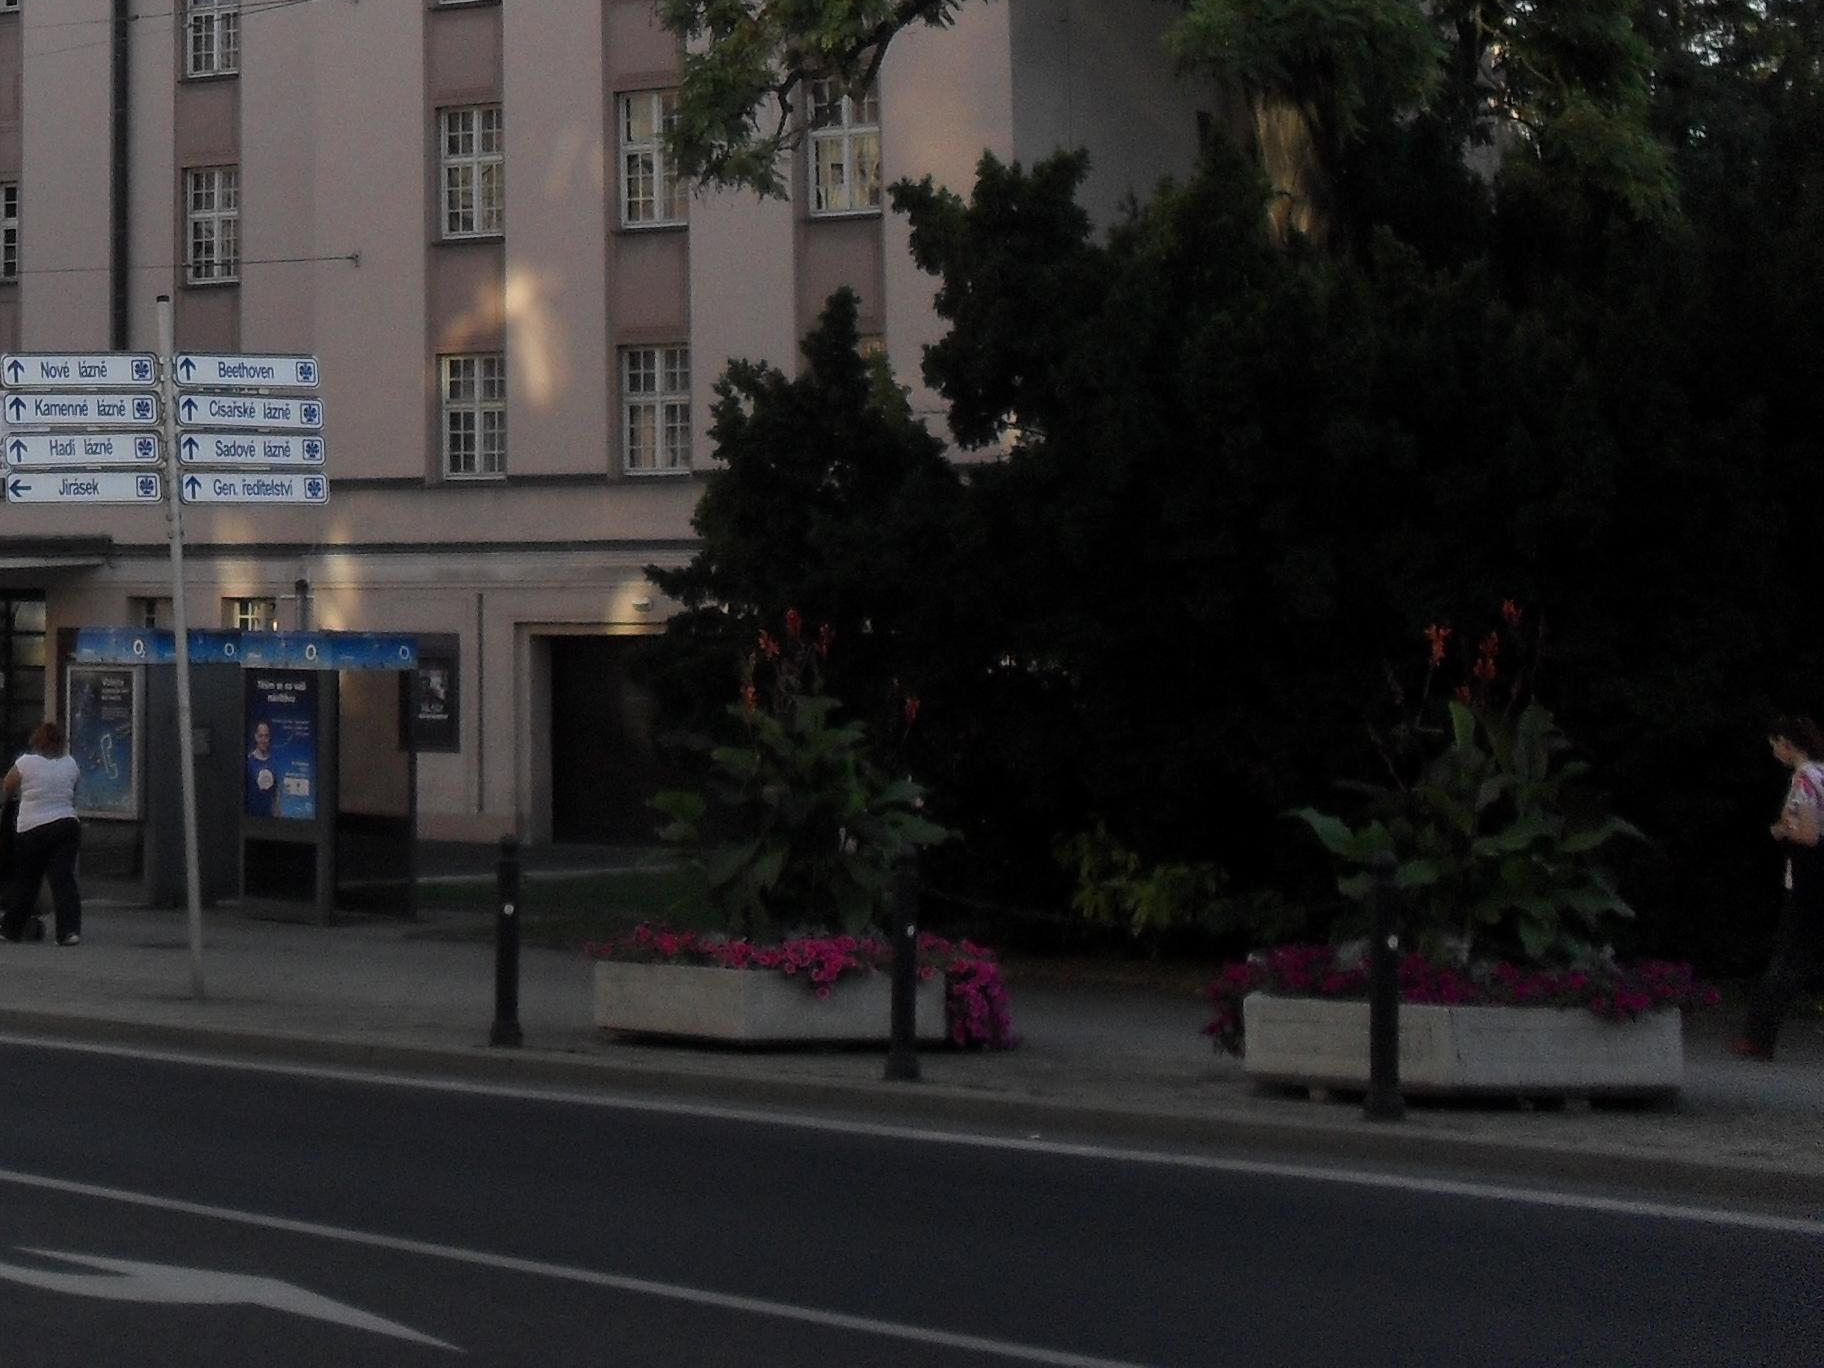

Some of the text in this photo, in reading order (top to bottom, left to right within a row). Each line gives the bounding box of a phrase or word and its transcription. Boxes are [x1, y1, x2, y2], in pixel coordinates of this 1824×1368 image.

[40, 360, 108, 378] Nové lázně
[217, 361, 275, 379] Beethoven
[34, 398, 126, 417] Kamenné lázně
[209, 400, 291, 420] Císařské lázně
[49, 438, 114, 457] Hadí lázně
[215, 439, 291, 458] Sadové lázně
[58, 478, 100, 496] Jirásek
[213, 479, 294, 497] Gen. ředitelství
